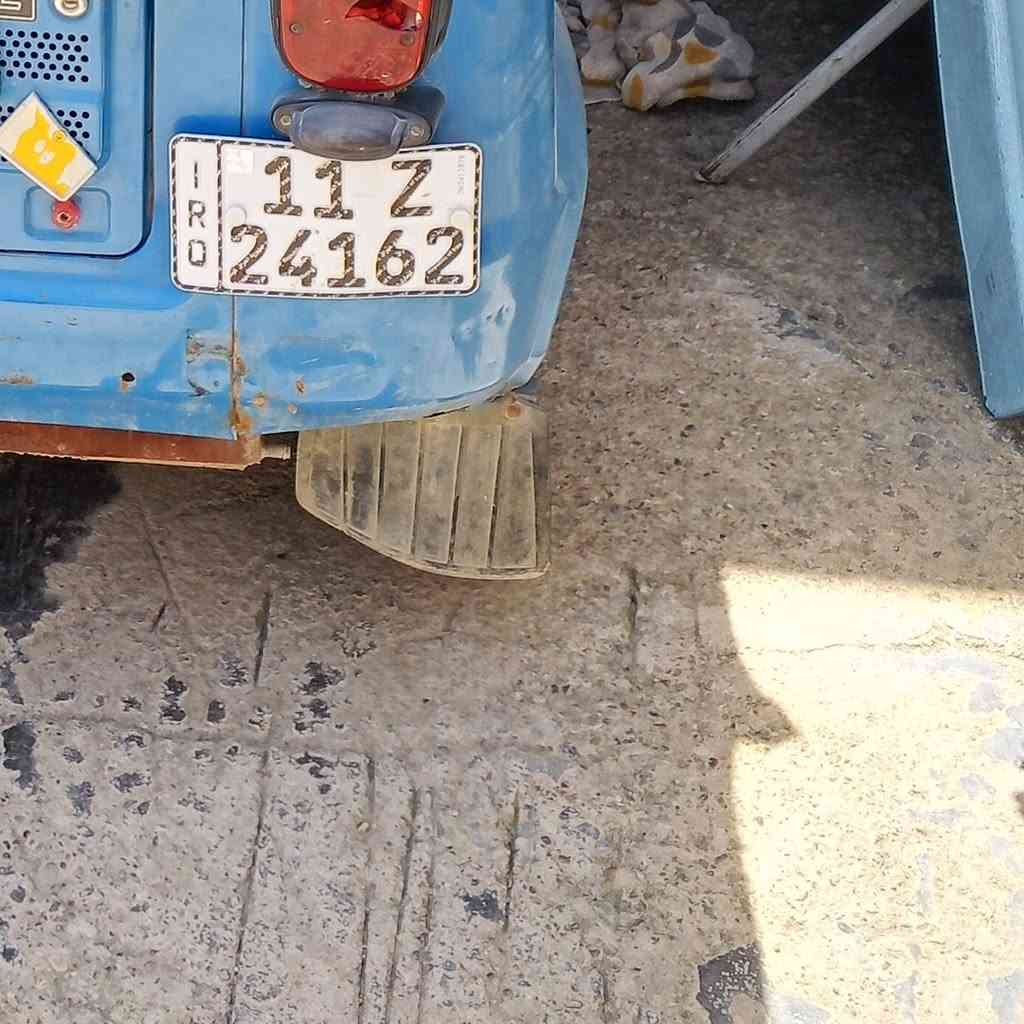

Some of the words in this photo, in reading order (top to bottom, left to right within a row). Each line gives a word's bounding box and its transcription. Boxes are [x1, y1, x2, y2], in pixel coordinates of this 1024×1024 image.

[264, 156, 354, 219] 11
[390, 159, 432, 217] Z
[229, 224, 464, 288] 24162
